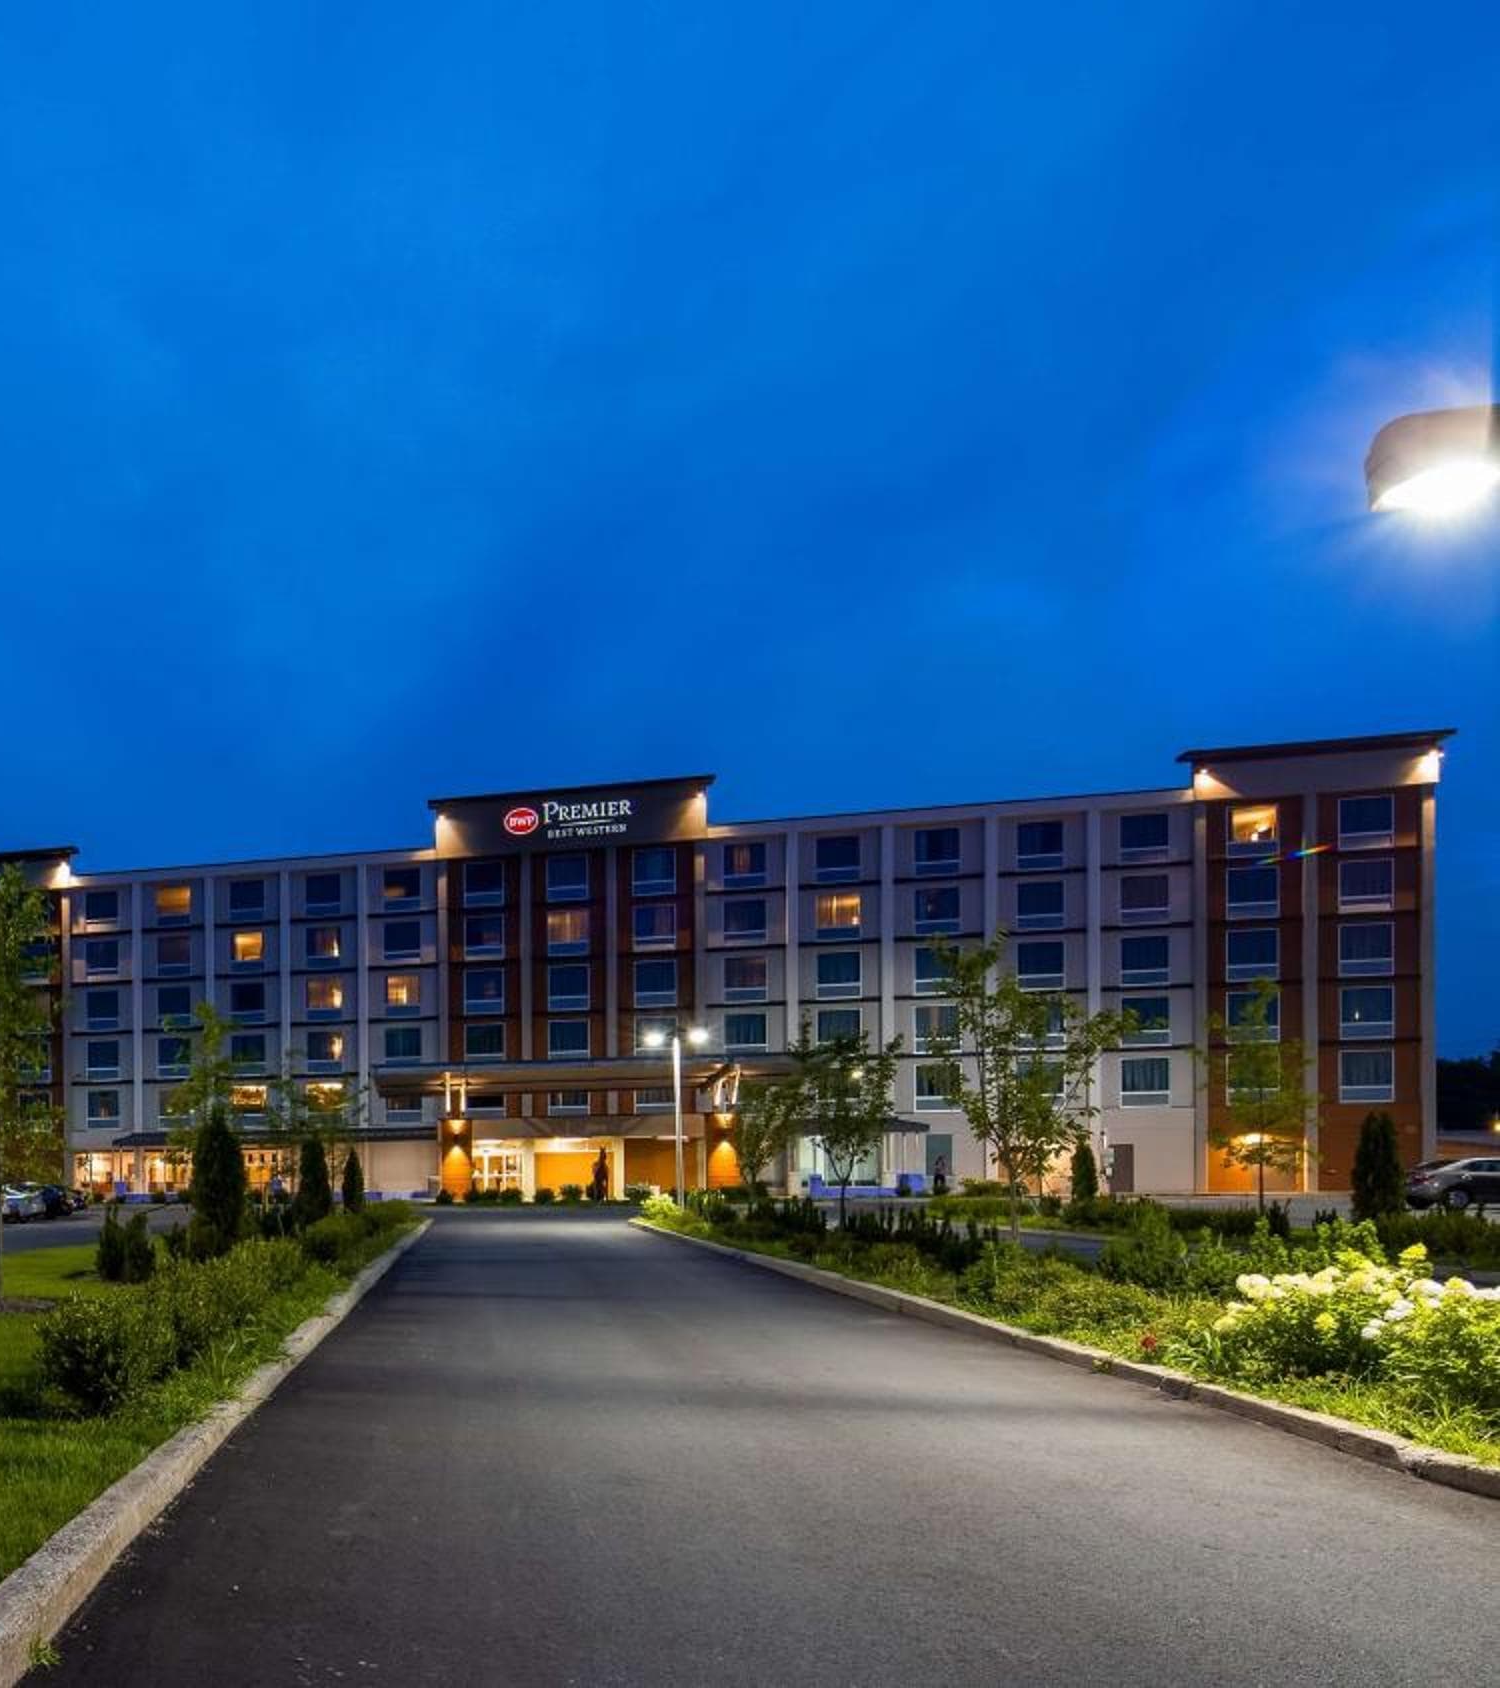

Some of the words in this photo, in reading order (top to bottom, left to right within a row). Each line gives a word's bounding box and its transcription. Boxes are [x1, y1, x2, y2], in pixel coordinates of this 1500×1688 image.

[543, 800, 632, 824] PREMIER
[548, 829, 573, 839] BEST
[576, 823, 627, 837] WESTERN
